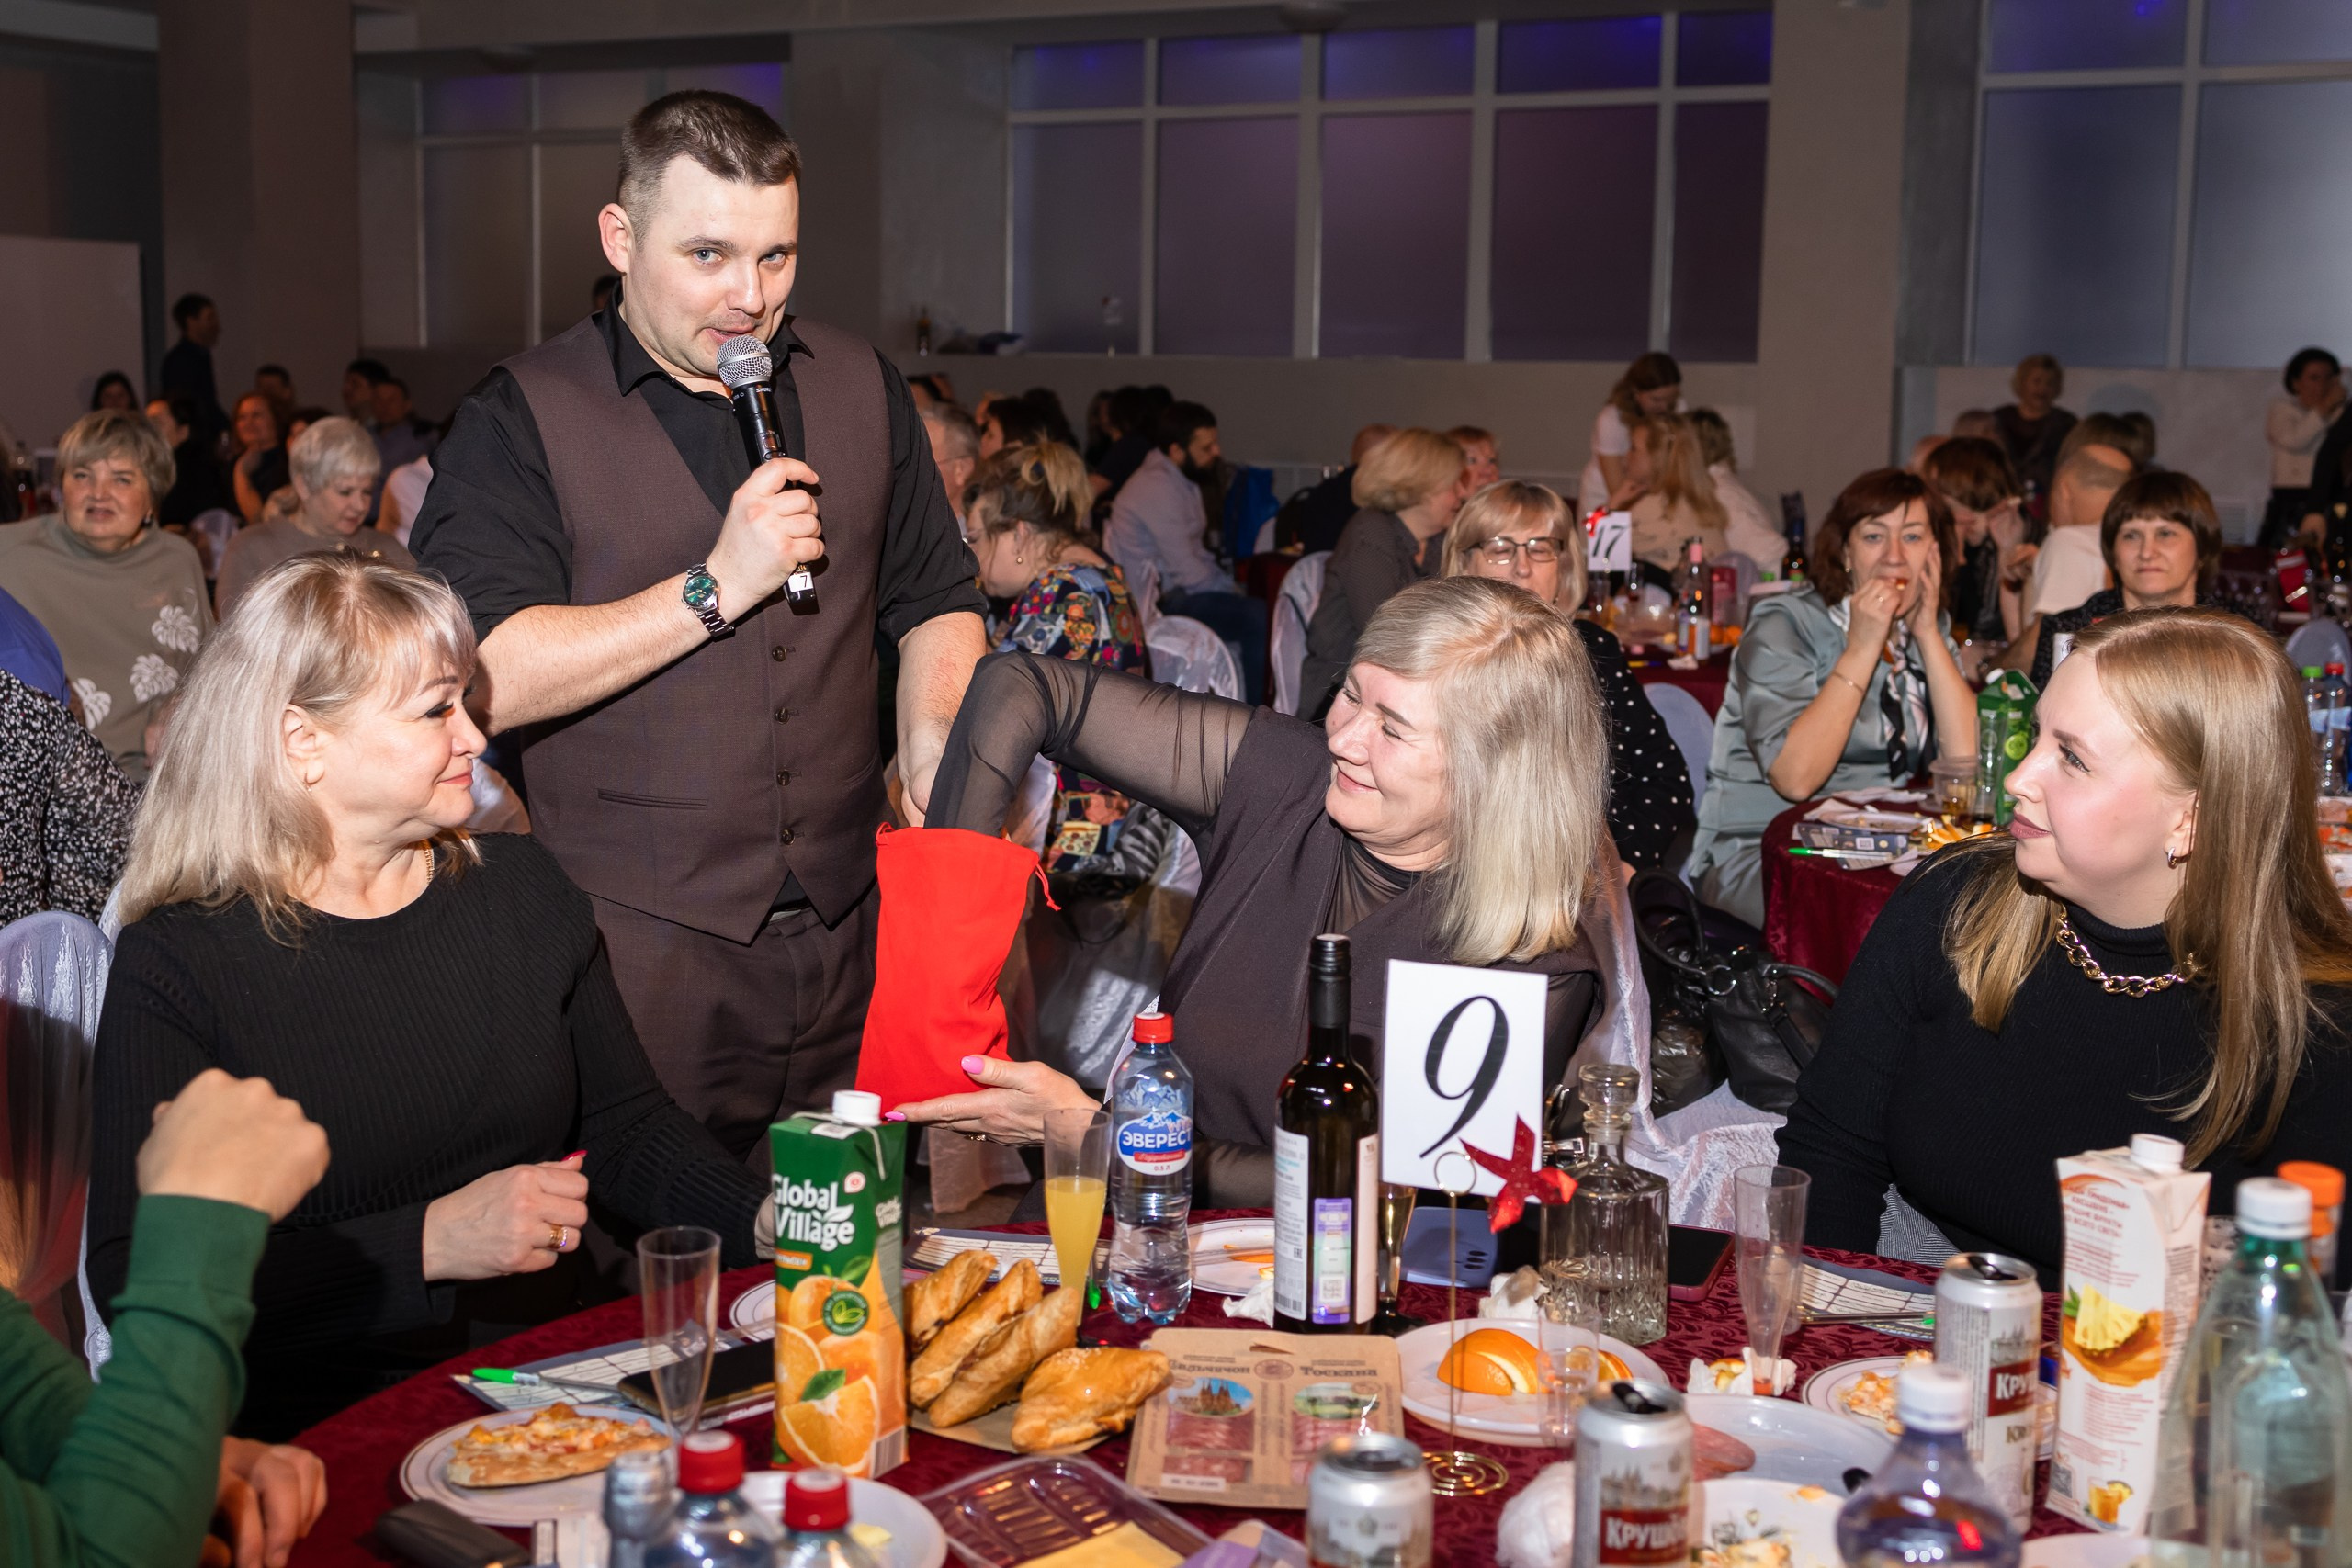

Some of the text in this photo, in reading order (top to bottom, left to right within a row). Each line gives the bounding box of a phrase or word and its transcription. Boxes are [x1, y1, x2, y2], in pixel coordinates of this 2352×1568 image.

[1592, 525, 1629, 559] 17
[800, 575, 808, 588] 7
[1419, 995, 1509, 1158] 9
[775, 1206, 855, 1252] Village
